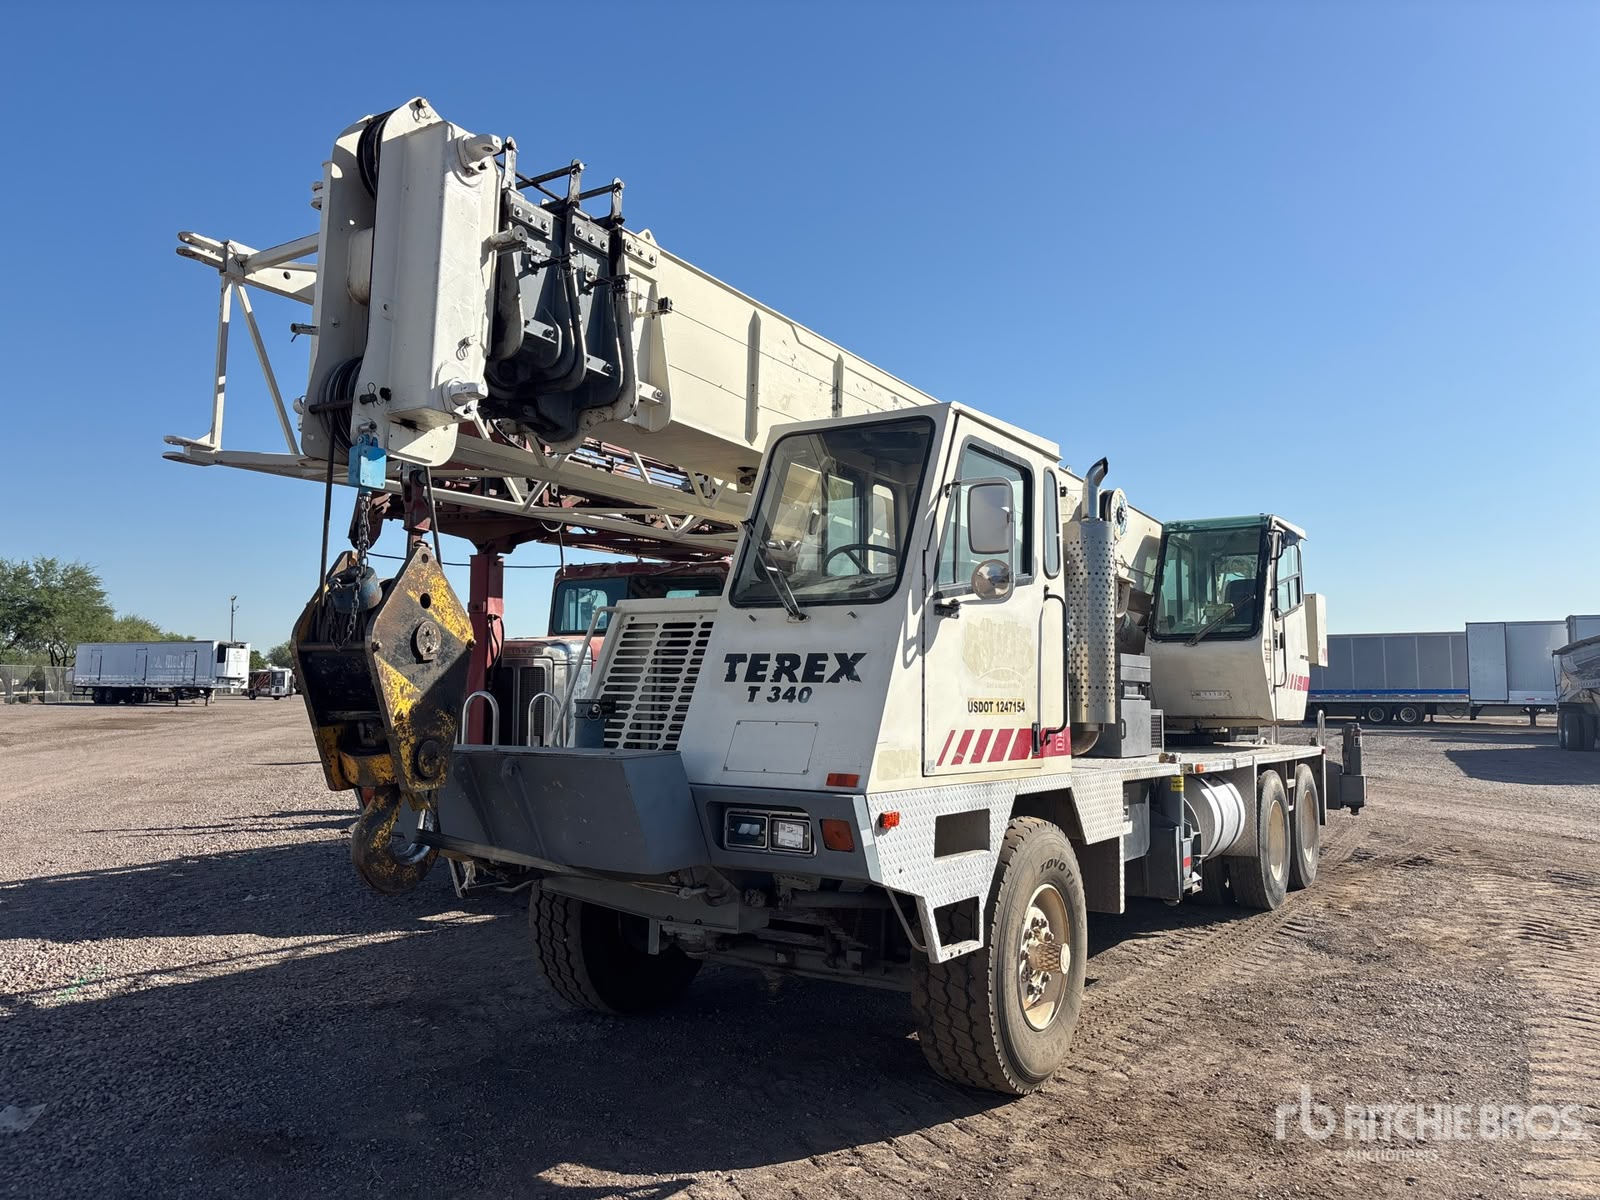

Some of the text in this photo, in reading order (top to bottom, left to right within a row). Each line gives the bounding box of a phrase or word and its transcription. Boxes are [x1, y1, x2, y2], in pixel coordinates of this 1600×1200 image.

[724, 652, 867, 683] TEREX
[747, 686, 813, 703] T 340
[967, 701, 1025, 713] USDOT 1247154
